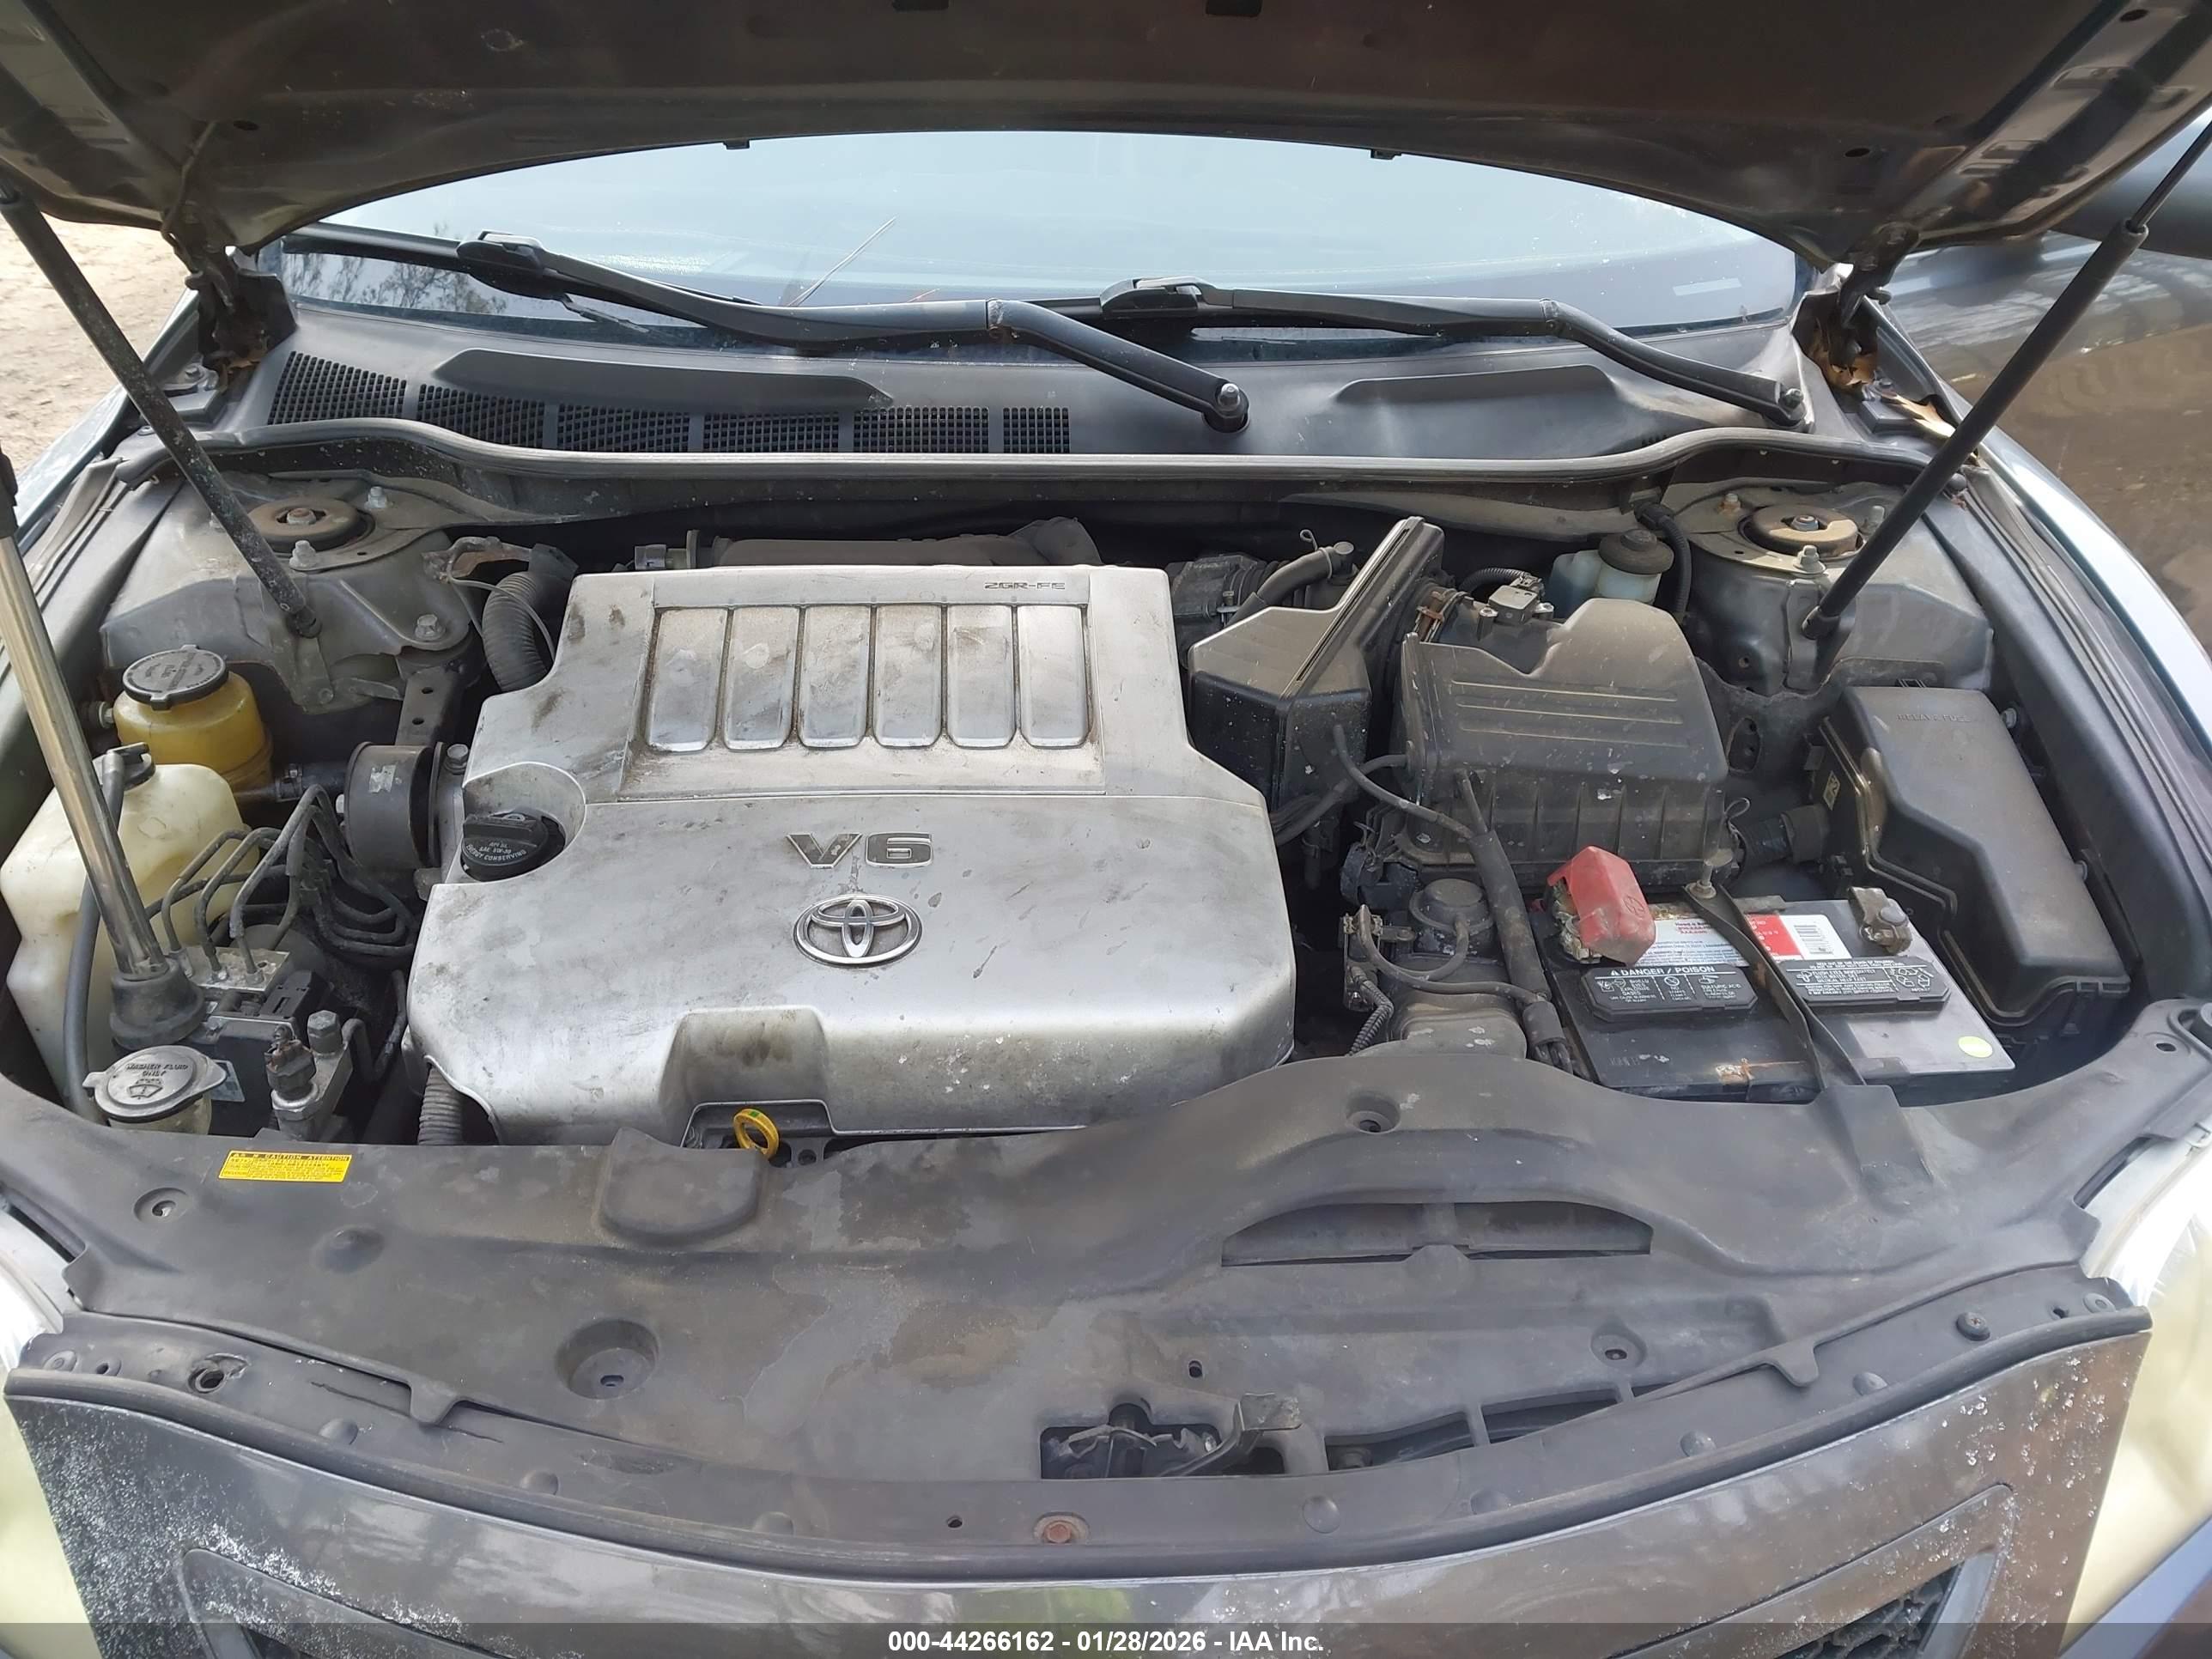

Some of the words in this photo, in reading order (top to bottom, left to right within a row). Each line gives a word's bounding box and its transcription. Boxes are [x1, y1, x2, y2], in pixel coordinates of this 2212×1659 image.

[483, 848, 527, 861] CONSERVING
[787, 833, 934, 869] V6
[1620, 968, 1664, 976] DANGER
[1675, 965, 1716, 974] POISON
